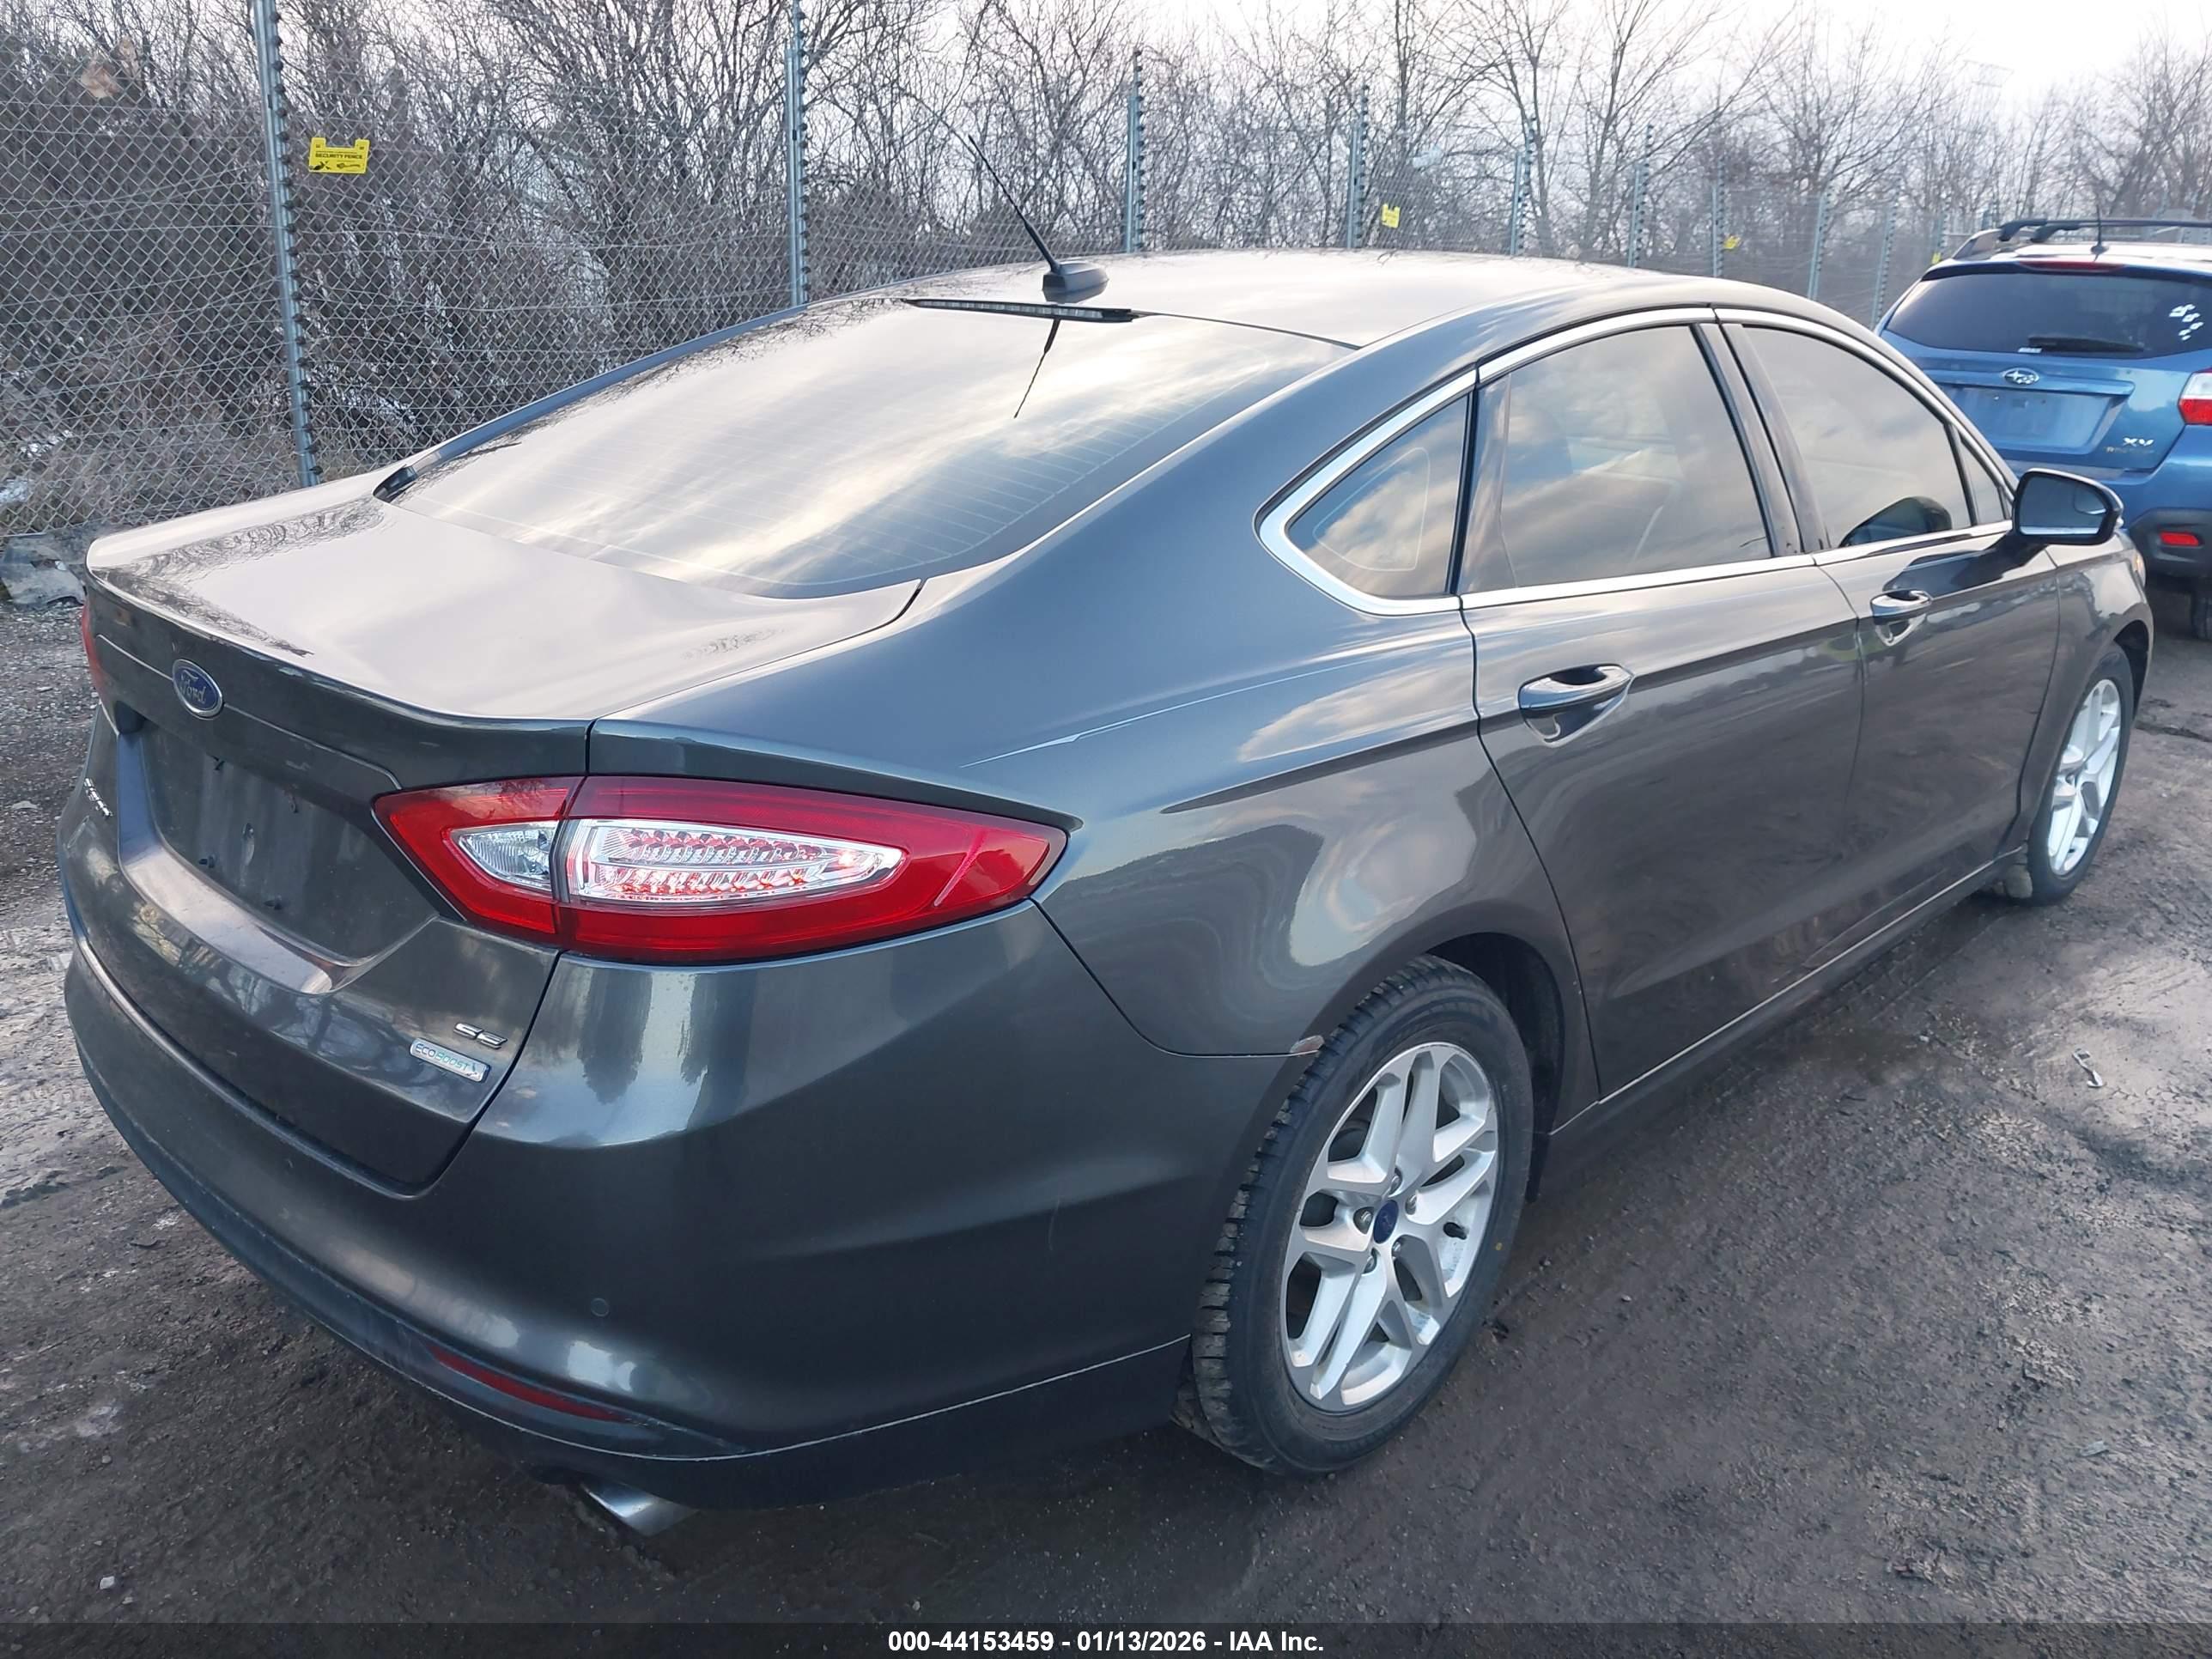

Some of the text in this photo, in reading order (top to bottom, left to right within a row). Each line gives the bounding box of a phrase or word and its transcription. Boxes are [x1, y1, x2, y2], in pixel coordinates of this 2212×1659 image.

[179, 669, 207, 704] Ford
[454, 1023, 508, 1047] SE
[416, 1043, 471, 1070] ECOBOOST
